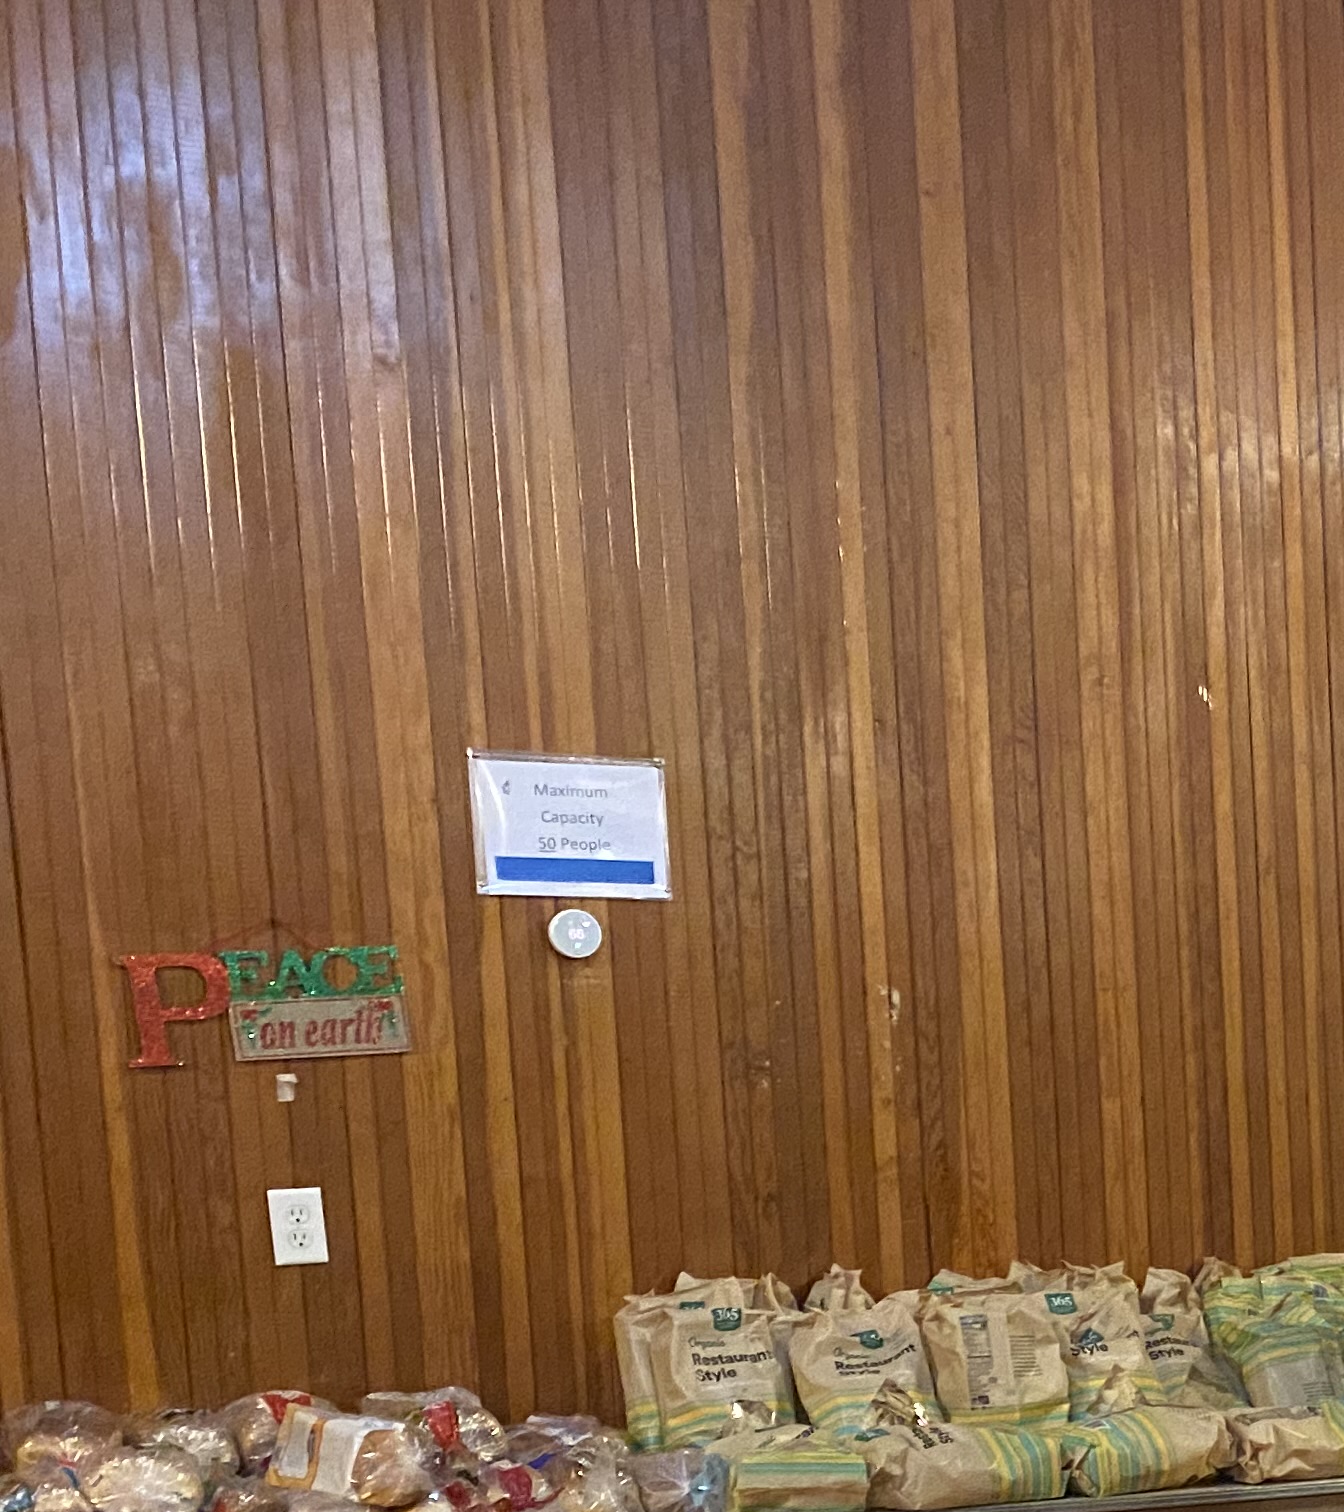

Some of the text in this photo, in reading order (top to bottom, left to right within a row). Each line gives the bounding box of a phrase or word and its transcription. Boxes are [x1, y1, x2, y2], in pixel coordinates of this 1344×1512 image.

[533, 783, 608, 798] Maximum
[541, 810, 604, 827] Capacity
[538, 836, 611, 853] 50 People
[116, 945, 404, 1068] PEACE
[260, 1008, 383, 1050] on earth
[1049, 1296, 1074, 1308] 365
[691, 1349, 776, 1366] Restaurant
[1070, 1342, 1109, 1357] Style
[1149, 1347, 1185, 1360] Style
[695, 1367, 738, 1382] Style
